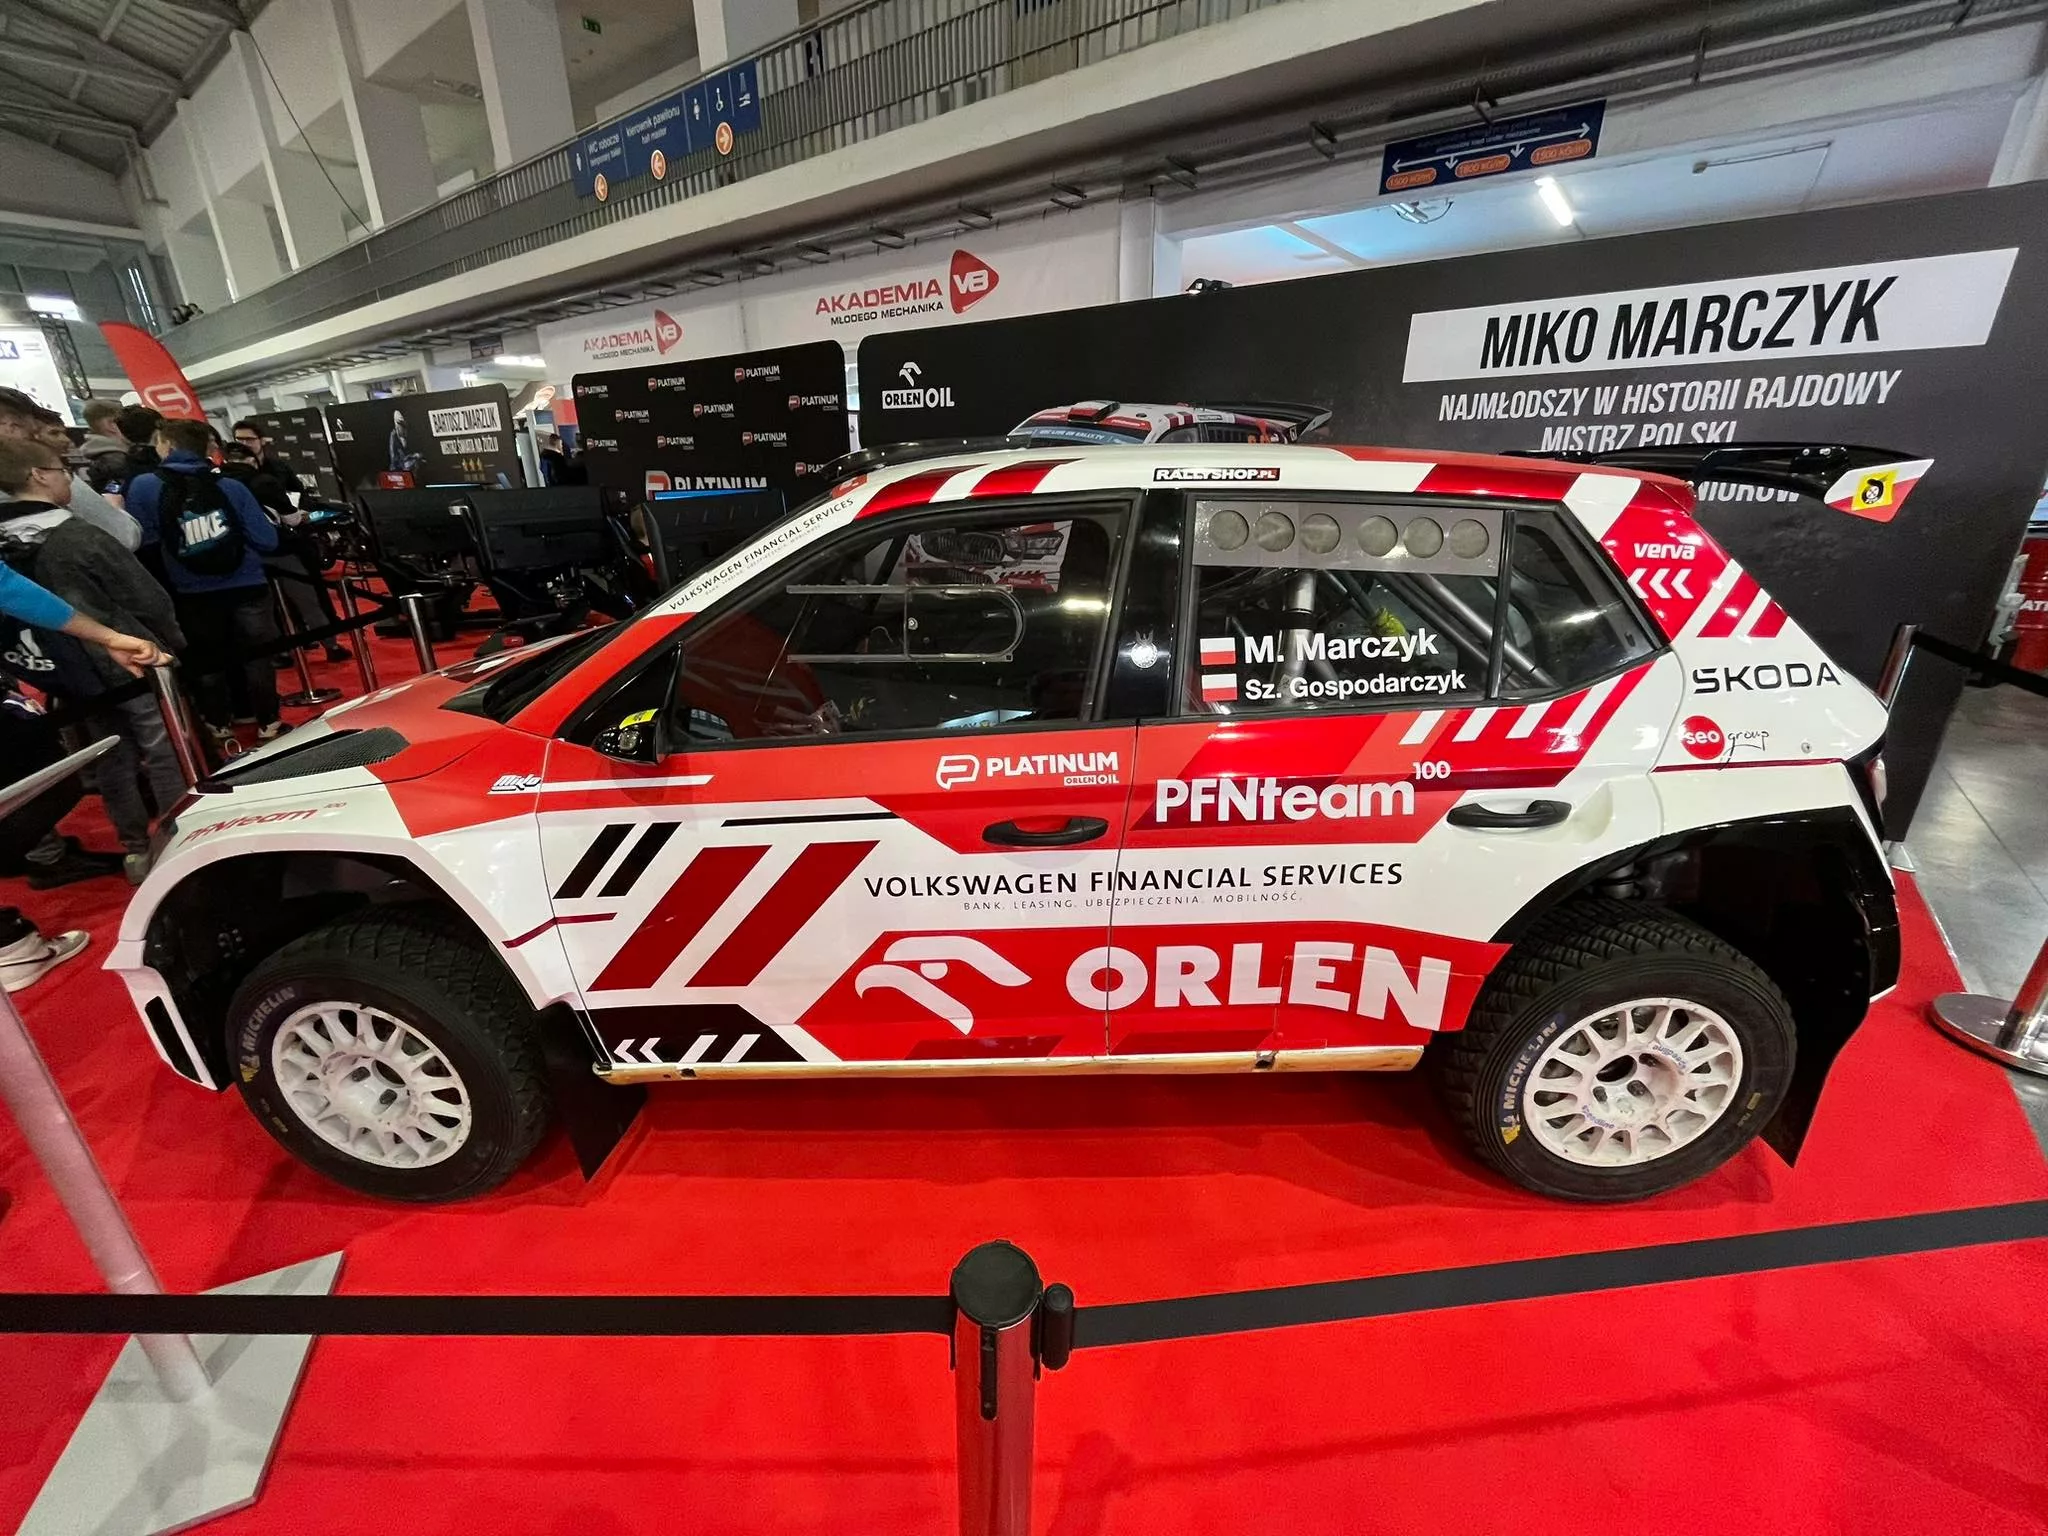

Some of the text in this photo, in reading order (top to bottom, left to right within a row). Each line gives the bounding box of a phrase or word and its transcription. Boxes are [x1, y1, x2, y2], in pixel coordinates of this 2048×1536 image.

[653, 106, 680, 128] pawilonu
[588, 134, 620, 154] WC robocze
[952, 270, 989, 294] V8
[815, 279, 943, 315] AKADEMIA
[830, 301, 944, 326] MŁODEGO MECHANIKA
[1480, 274, 1899, 370] MIKO MARCZYK
[584, 329, 653, 352] AKADEMIA
[658, 377, 686, 388] PLATINUM
[746, 365, 780, 378] PLATINUM
[704, 403, 735, 414] PLATINUM
[801, 394, 839, 406] PLATINUM
[884, 387, 955, 408] ORLEN OIL
[1438, 370, 1903, 422] NAJMŁODSZY W HISTORII RAJDOWY
[754, 432, 787, 442] PLATINUM
[1540, 420, 1738, 453] MISTRZ POLSKI
[180, 511, 227, 546] NIKE
[669, 560, 742, 611] VOLKSWAGEN
[744, 526, 802, 563] FINANCIAL
[803, 498, 854, 529] SERVICES
[1634, 542, 1696, 560] verva
[1244, 628, 1439, 664] M. Marczyk
[1245, 670, 1467, 700] Sz. Gospodarczyk
[1685, 729, 1770, 771] seo group
[986, 752, 1119, 777] PLATINUM
[1066, 774, 1120, 786] ORLEN OIL
[1155, 760, 1451, 823] PFNteam 100
[864, 863, 1403, 898] VOLKSWAGEN FINANCIAL SERVICES
[964, 902, 1004, 910] BANK.
[1013, 899, 1077, 910] LEASING.
[1066, 941, 1453, 1032] ORLEN
[242, 986, 296, 1052] MICHELIN
